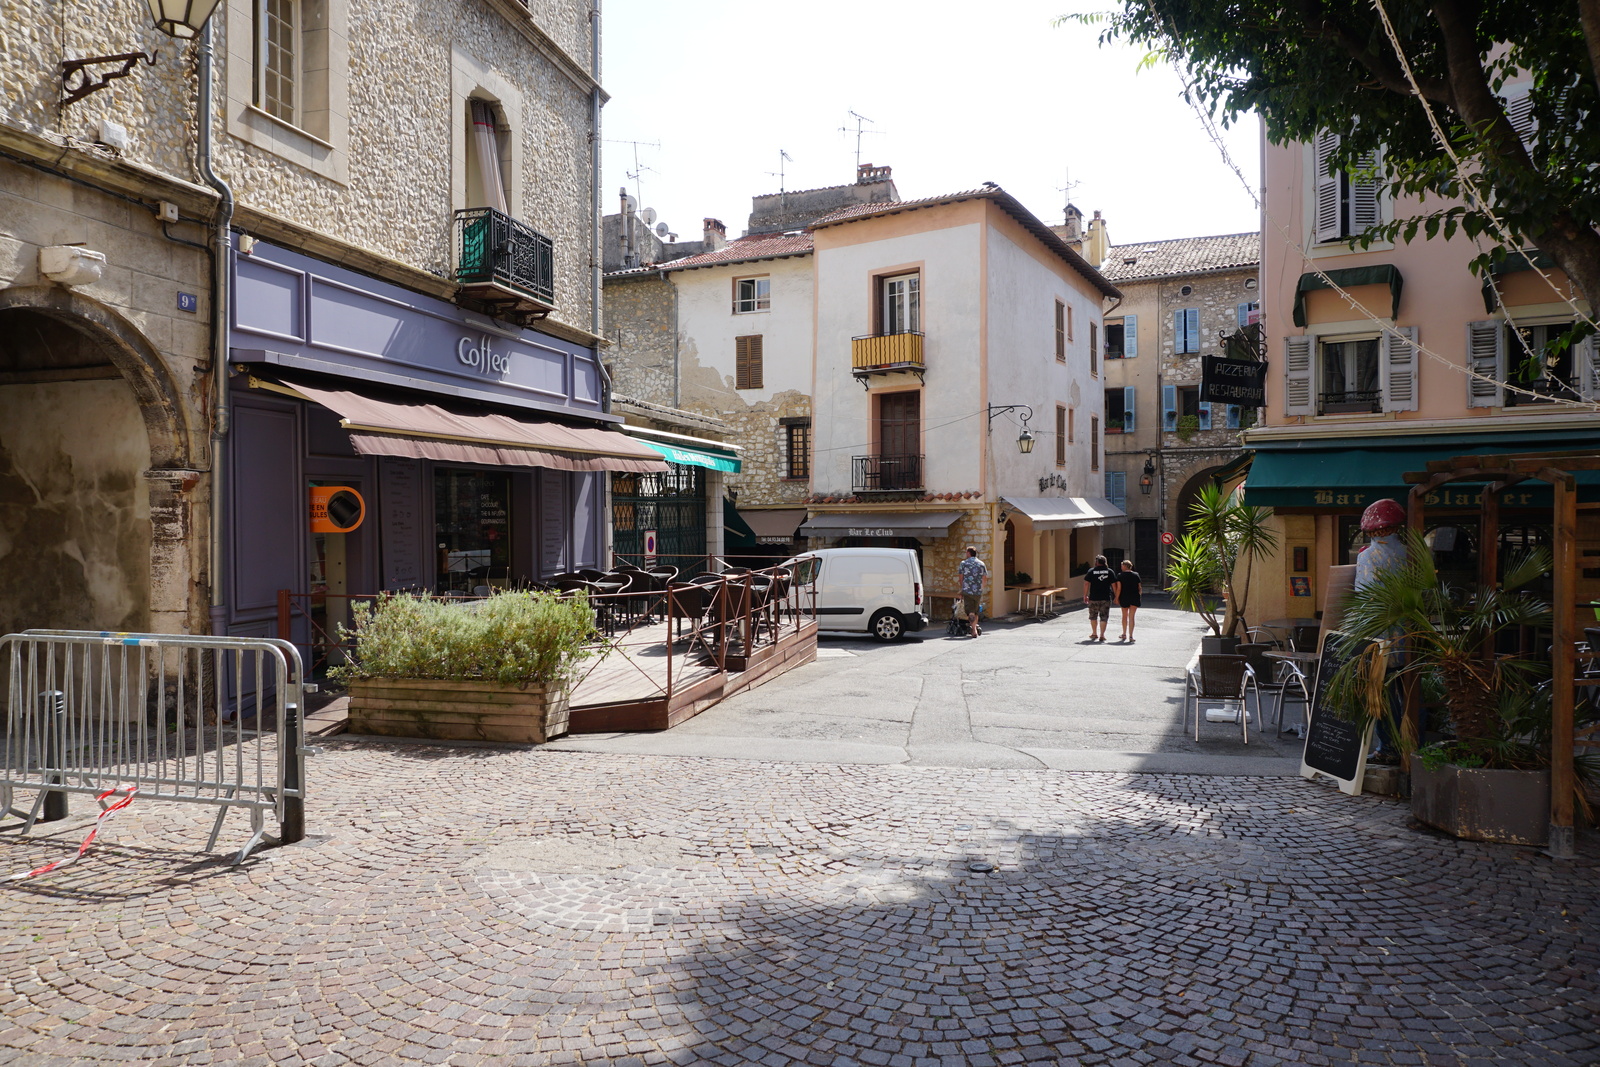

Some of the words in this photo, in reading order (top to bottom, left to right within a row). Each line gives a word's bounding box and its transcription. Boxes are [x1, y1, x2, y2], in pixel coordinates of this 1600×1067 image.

[182, 295, 189, 308] 9
[458, 334, 511, 376] Coffea
[1214, 363, 1258, 378] PIZZERIA
[1209, 383, 1263, 399] RESTAURANT
[1313, 490, 1366, 505] Bar
[1423, 490, 1533, 506] Glacer
[848, 528, 863, 537] Bar
[864, 528, 875, 536] Le
[875, 528, 894, 537] Club
